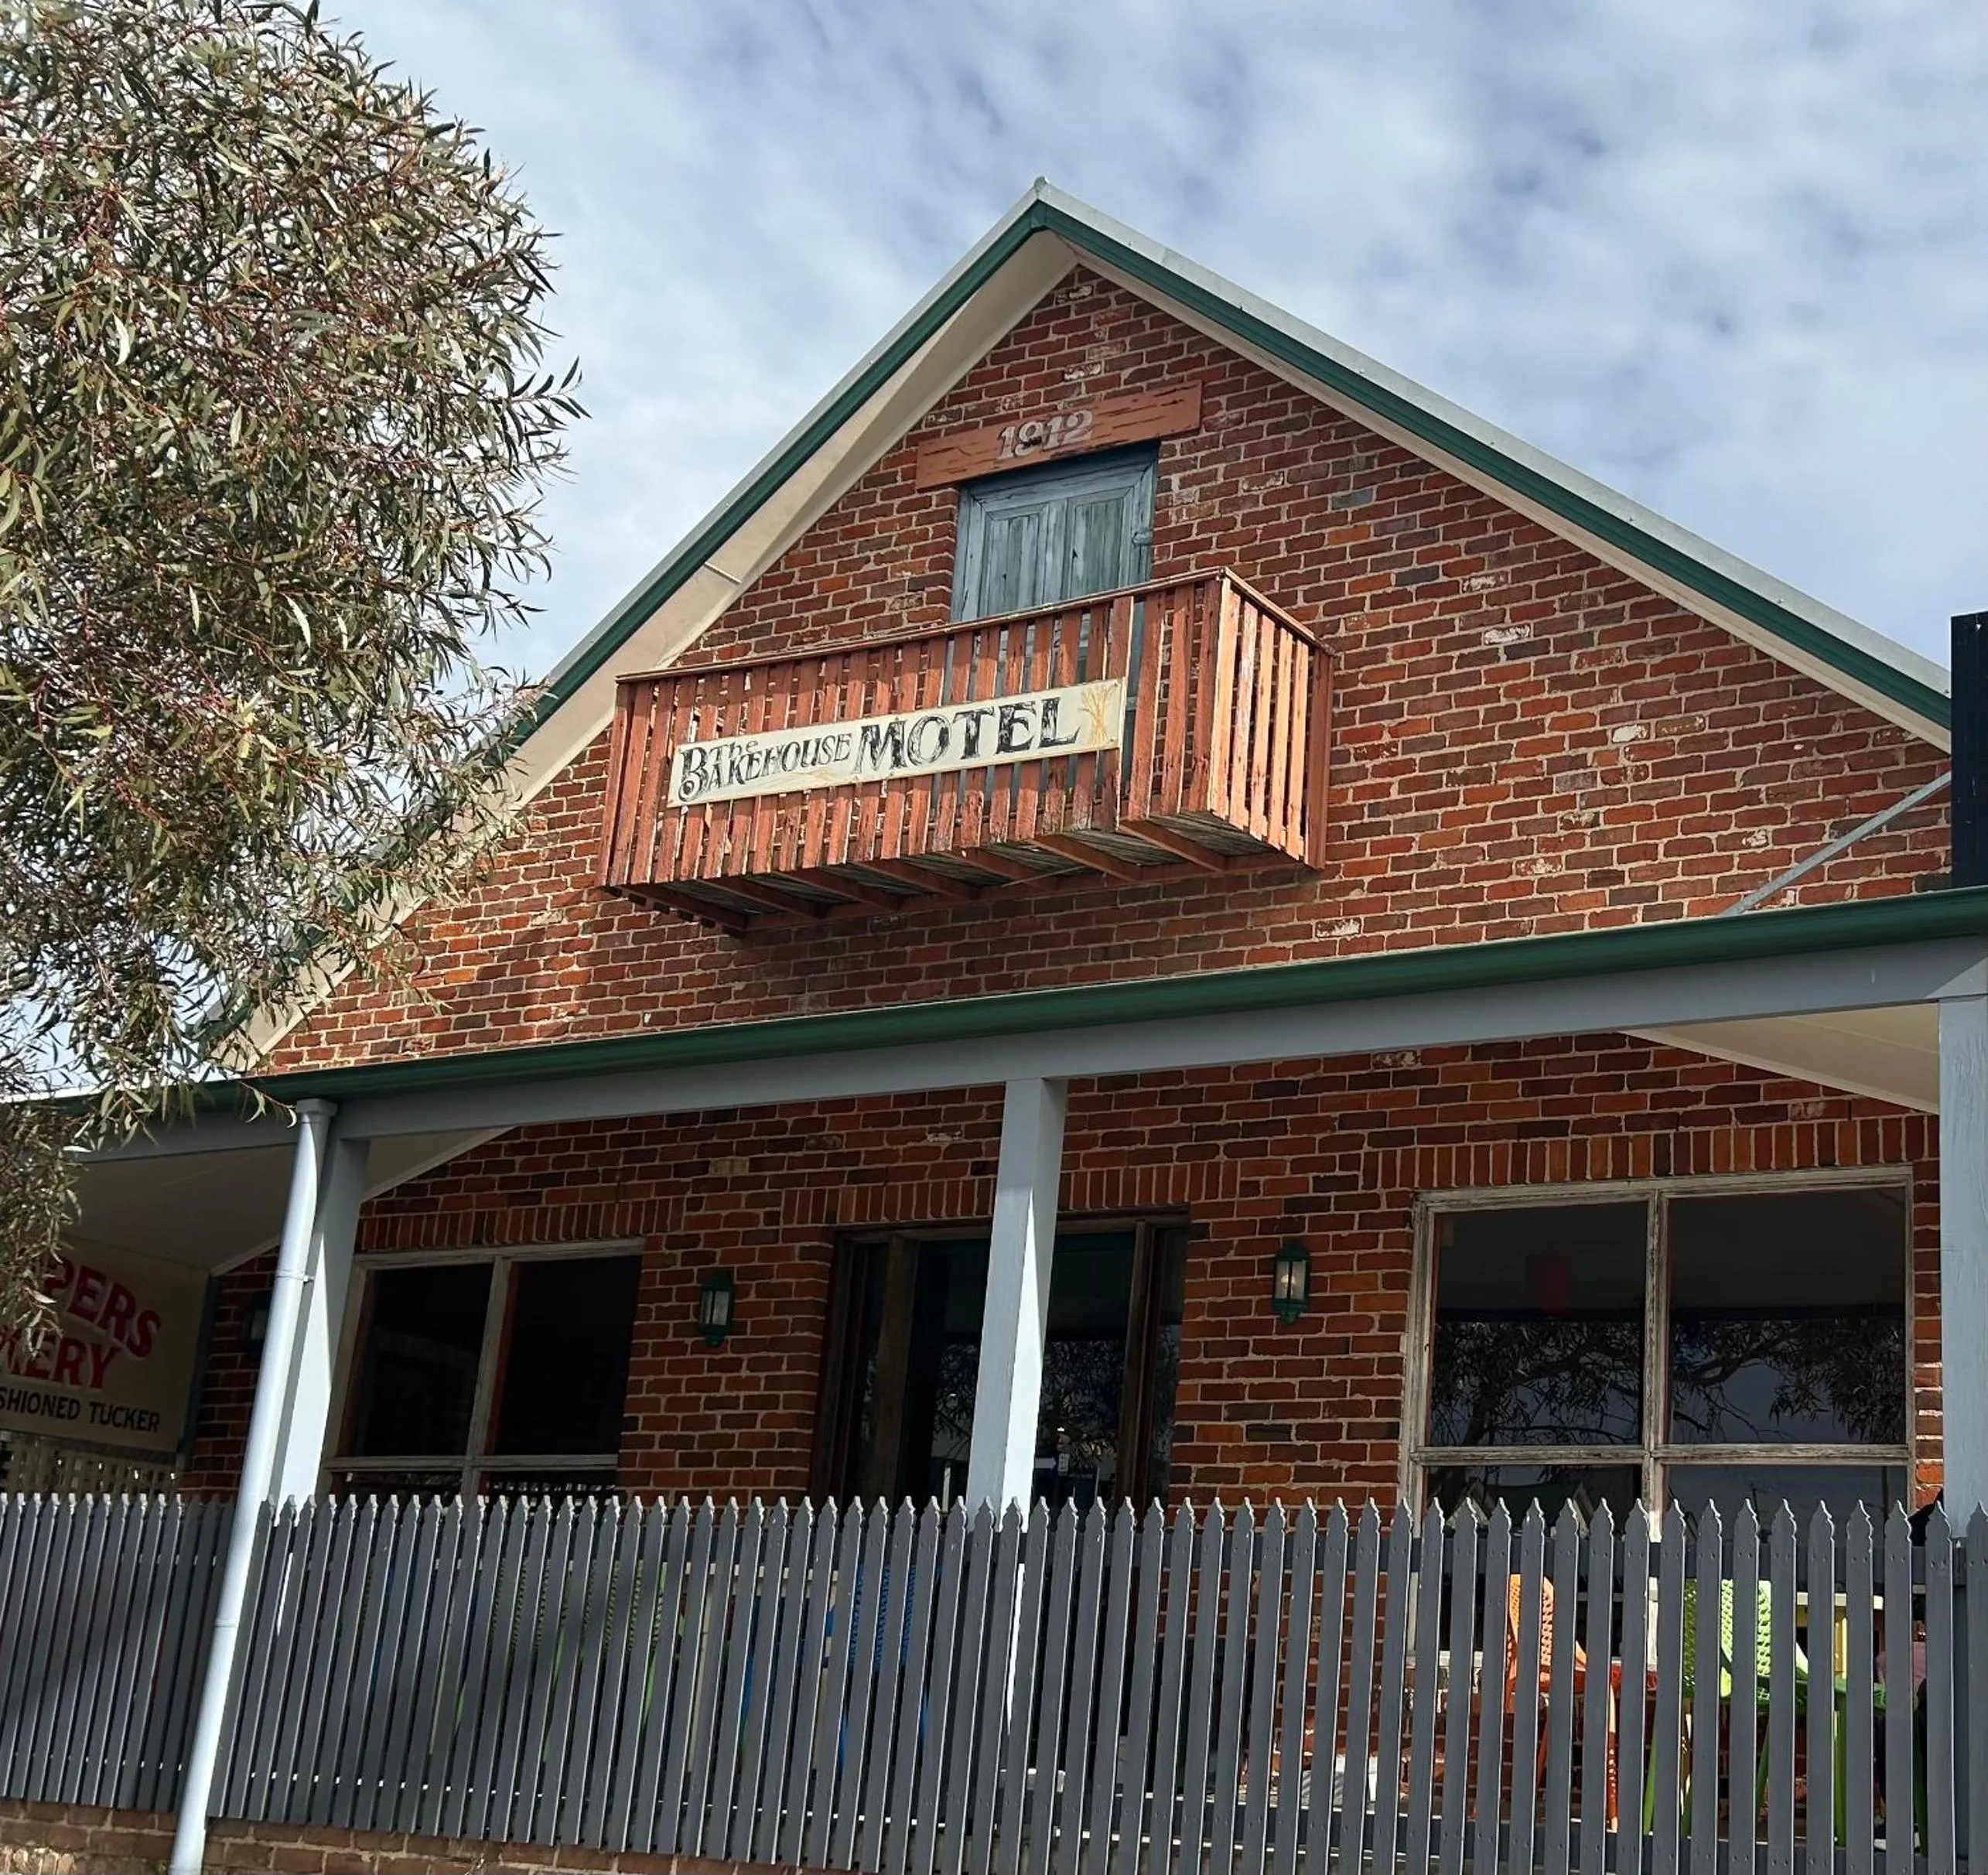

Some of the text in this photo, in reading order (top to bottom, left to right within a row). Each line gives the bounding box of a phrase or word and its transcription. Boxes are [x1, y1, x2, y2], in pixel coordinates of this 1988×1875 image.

[996, 410, 1093, 460] 1912
[678, 697, 1081, 801] BAKEHOUSE MOTEL
[709, 740, 759, 763] The
[90, 1402, 160, 1433] TUCKER
